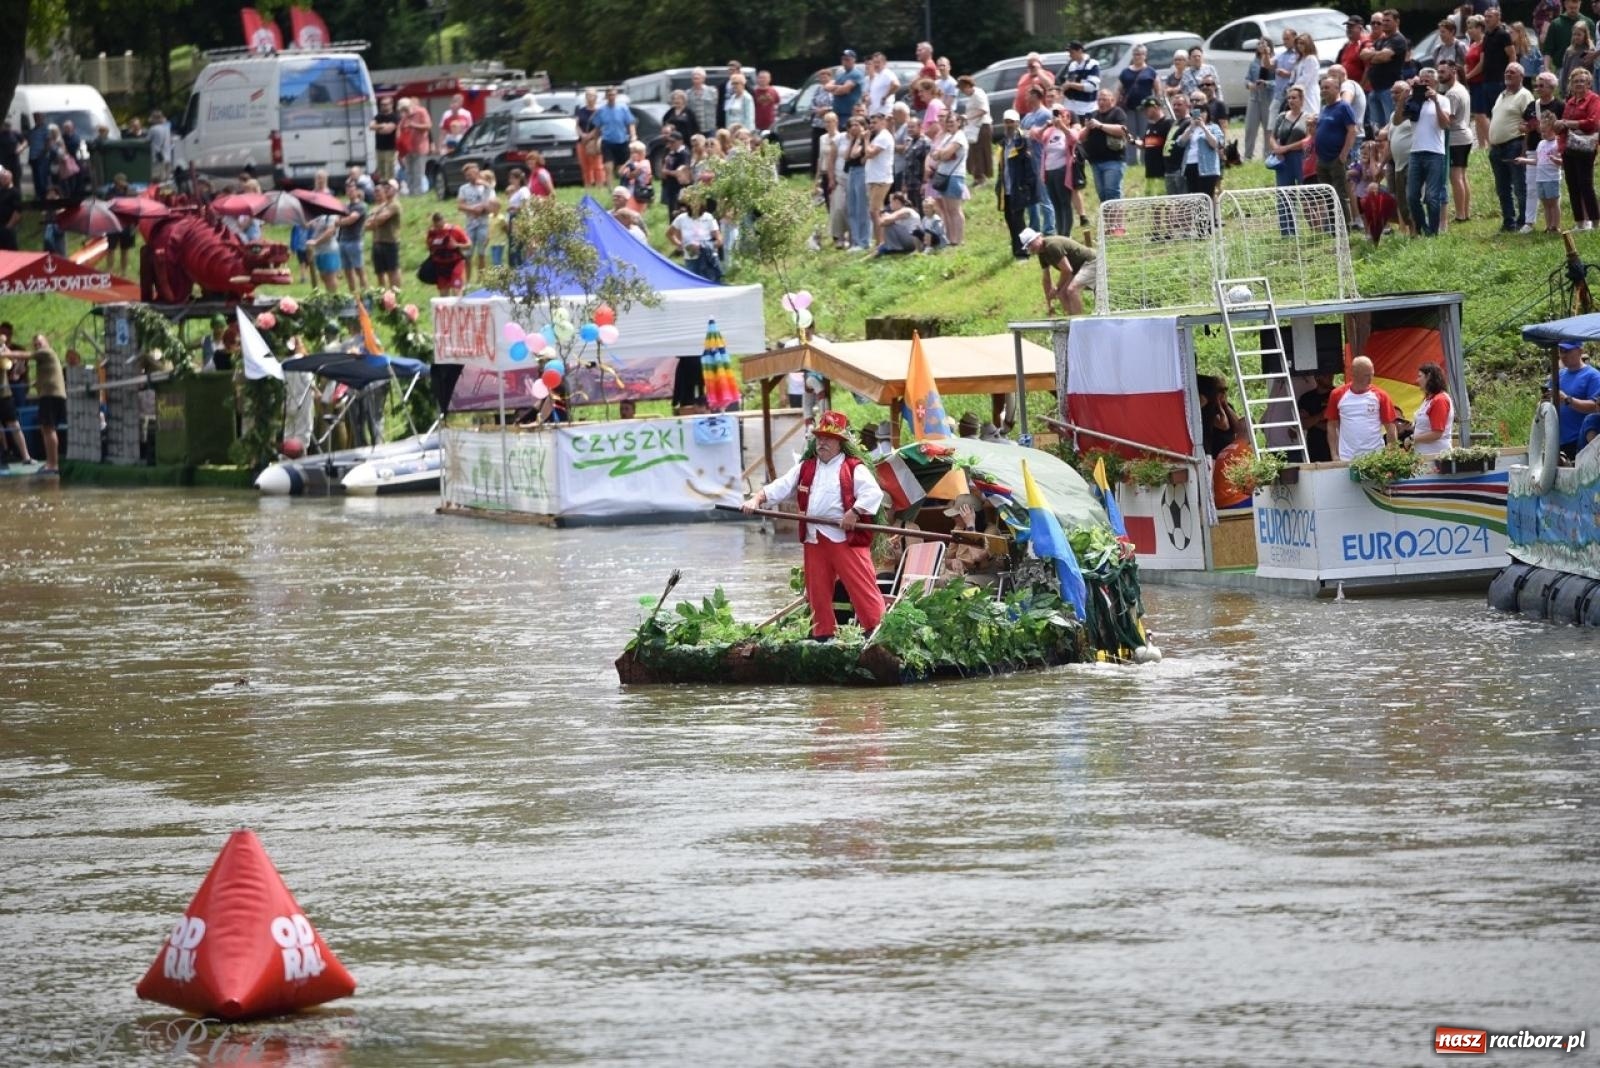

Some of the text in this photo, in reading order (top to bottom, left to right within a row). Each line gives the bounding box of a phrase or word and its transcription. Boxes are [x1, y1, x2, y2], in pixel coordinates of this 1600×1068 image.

[1258, 507, 1317, 549] EURO2024
[1343, 525, 1490, 561] EURO2024
[169, 914, 206, 949] OD
[270, 913, 315, 949] OD
